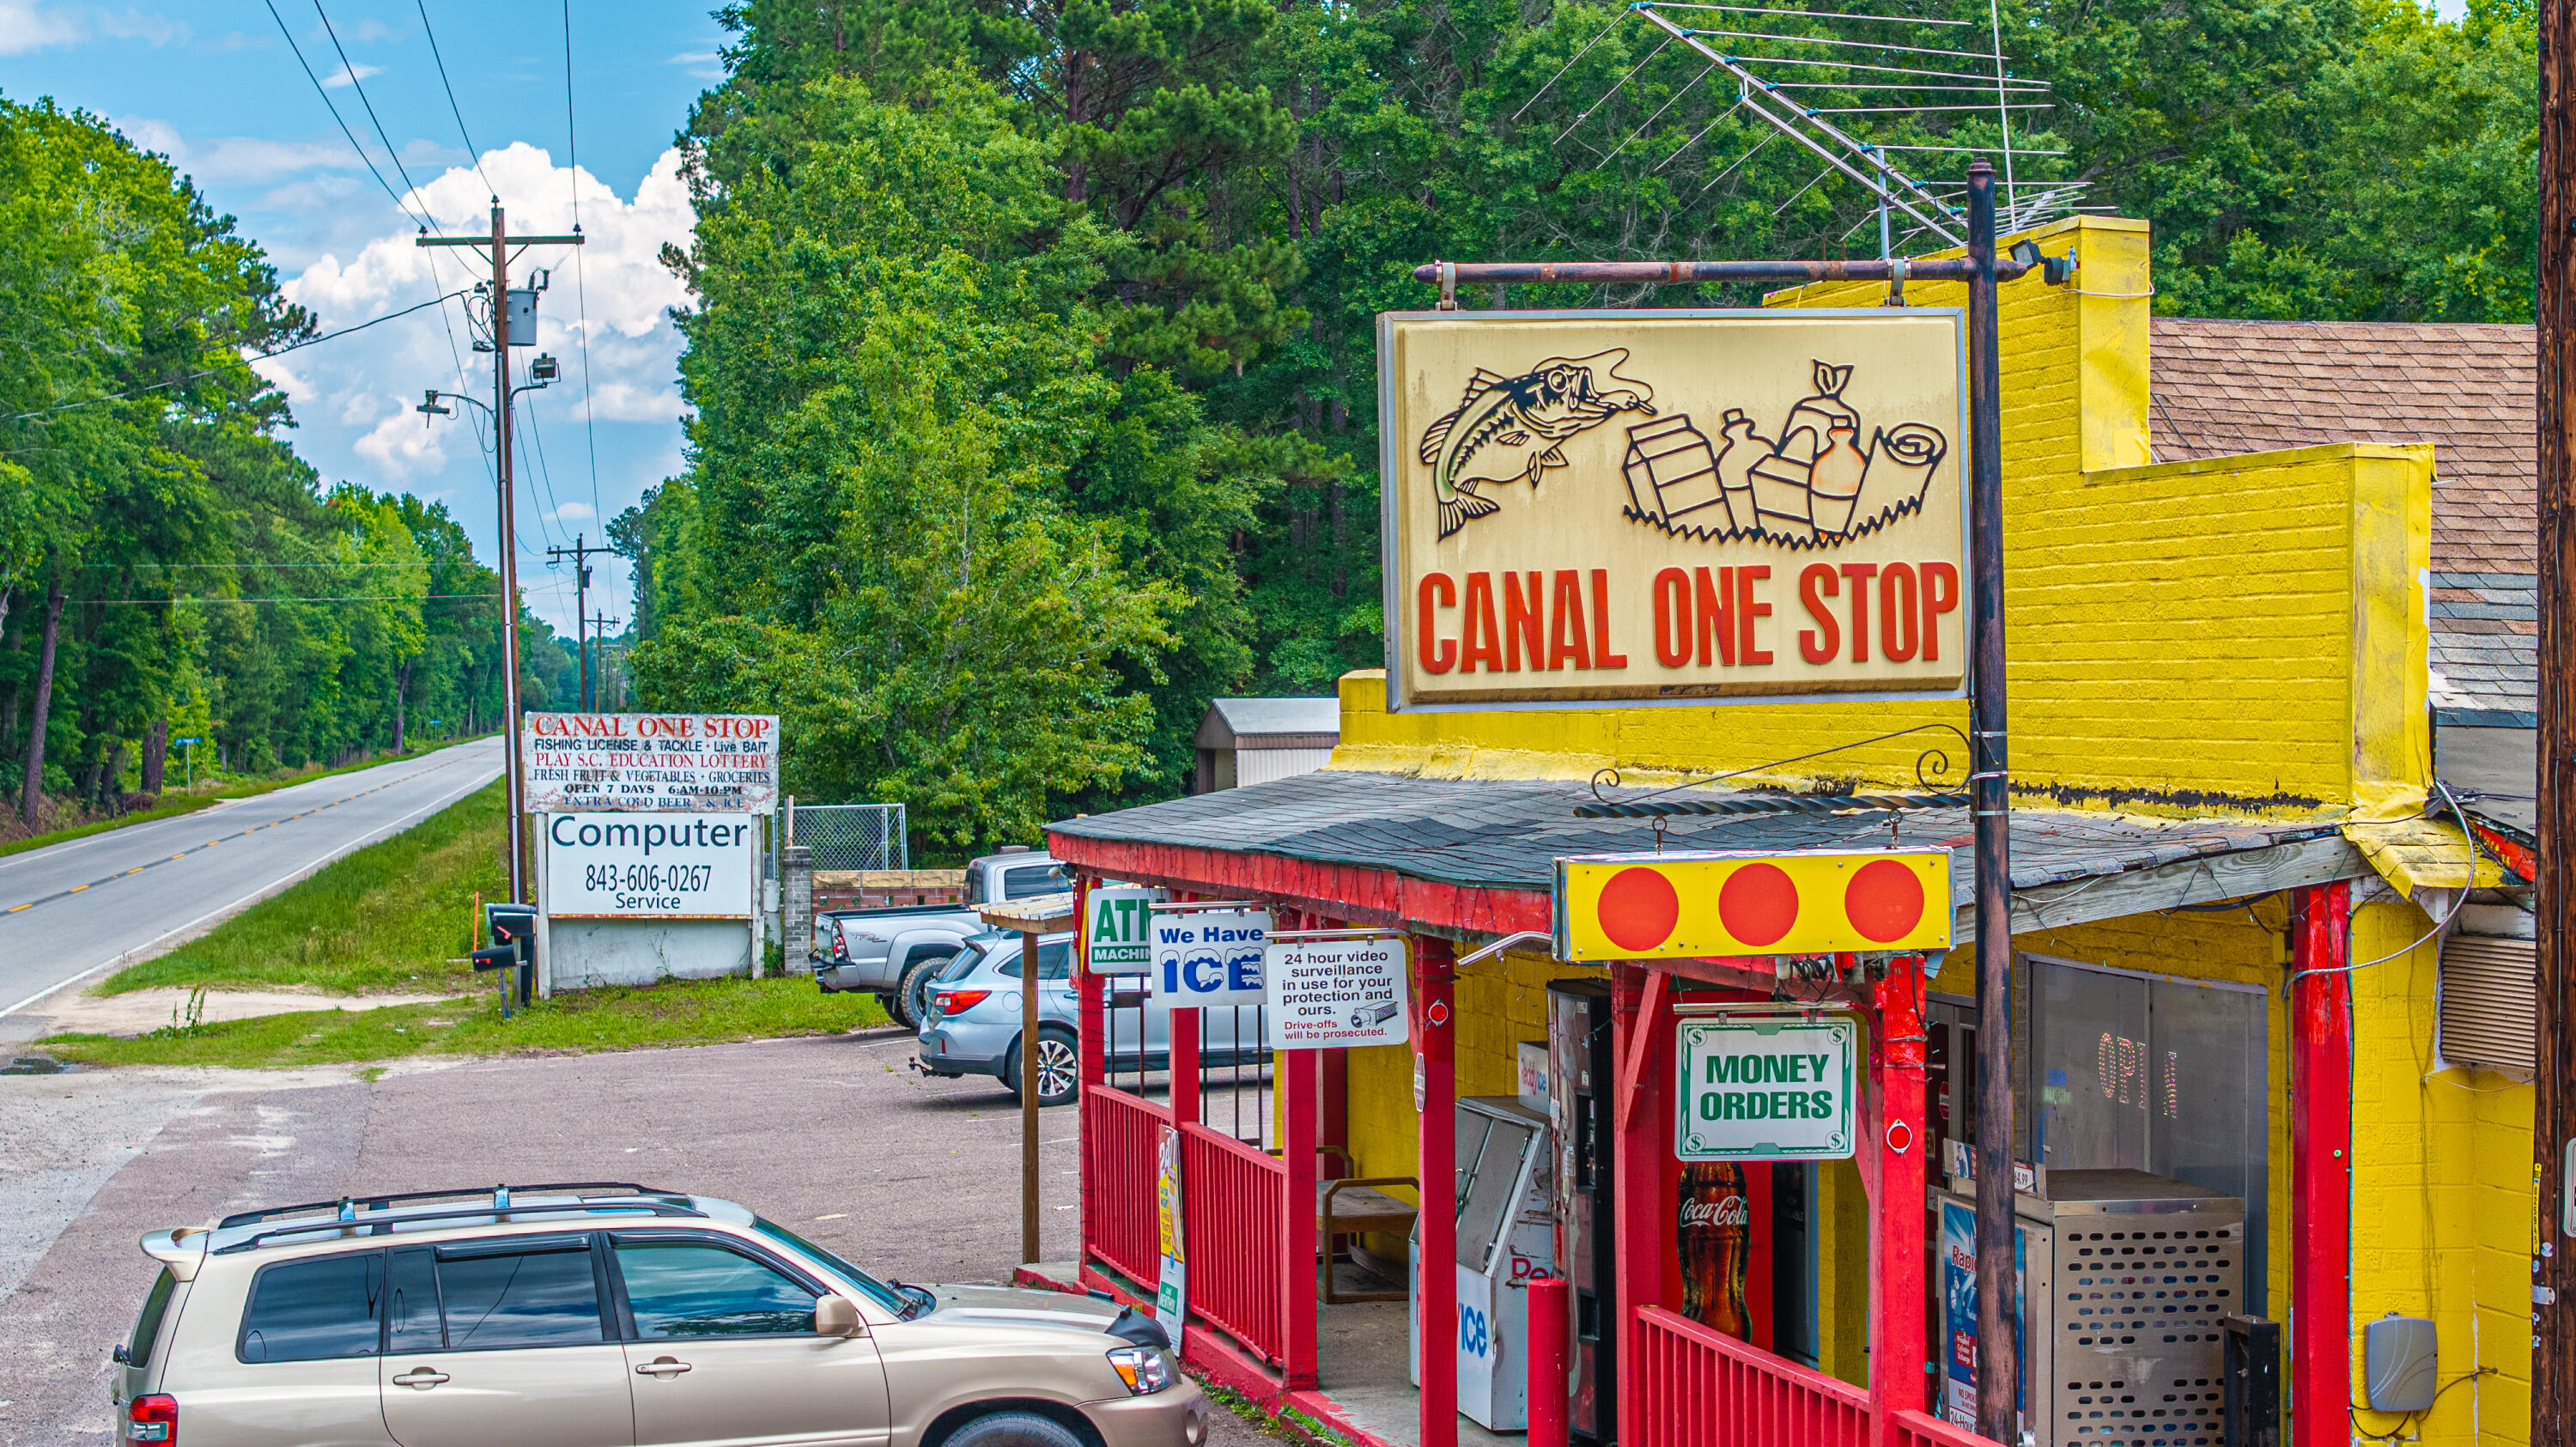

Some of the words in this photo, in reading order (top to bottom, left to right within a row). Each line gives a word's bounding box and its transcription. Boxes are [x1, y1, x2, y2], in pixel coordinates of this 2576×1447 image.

[1417, 568, 1628, 675] CANAL
[1653, 564, 1775, 668] ONE
[1798, 561, 1959, 666] STOP
[533, 715, 628, 738] CANAL
[636, 717, 695, 739] ONE
[703, 717, 769, 739] STOP
[534, 739, 582, 751] FISHING
[587, 739, 638, 751] LICENSE
[643, 739, 652, 751] &
[658, 739, 702, 752] TACKLE
[714, 740, 737, 752] Live
[742, 740, 769, 753] BAIT
[536, 752, 572, 766] PLAY
[577, 752, 603, 767] S.C.
[609, 752, 694, 768] EDUCATION
[700, 754, 768, 769] LOTTERY
[533, 769, 568, 781] FRESH
[573, 769, 607, 781] FRUIT
[610, 769, 621, 782] &
[626, 769, 696, 783] VEGETABLES
[708, 771, 771, 784] GROCERIES
[564, 783, 600, 793] OPEN
[606, 784, 614, 793] 7
[621, 784, 654, 794] DAYS
[564, 796, 612, 806] EXTRA
[617, 796, 653, 807] COLD
[658, 797, 691, 807] BEER
[706, 798, 715, 808] &
[551, 815, 748, 856] Computer
[586, 864, 712, 891] 843-606-0267
[615, 892, 681, 909] Service
[1159, 928, 1195, 944] We
[1203, 926, 1264, 944] Have
[1095, 948, 1151, 961] MACHIN
[1284, 953, 1303, 965] 24
[1308, 952, 1343, 964] hour
[1346, 951, 1388, 963] video
[1160, 945, 1265, 994] ICE
[1291, 964, 1383, 978] surveillance
[1282, 979, 1297, 991] in
[1301, 980, 1328, 990] use
[1333, 977, 1354, 989] for
[1358, 976, 1393, 991] your
[1283, 989, 1360, 1006] protection
[1364, 988, 1393, 1000] and
[1297, 1006, 1336, 1017] ours.
[1284, 1019, 1338, 1030] Drive-offs
[1285, 1031, 1303, 1040] will
[1306, 1030, 1320, 1039] be
[1323, 1027, 1388, 1040] prosecuted.
[1705, 1054, 1831, 1084] MONEY
[1699, 1090, 1833, 1121] ORDERS
[1679, 1195, 1749, 1228] Coca-Cola
[1952, 1244, 1977, 1274] Rapi
